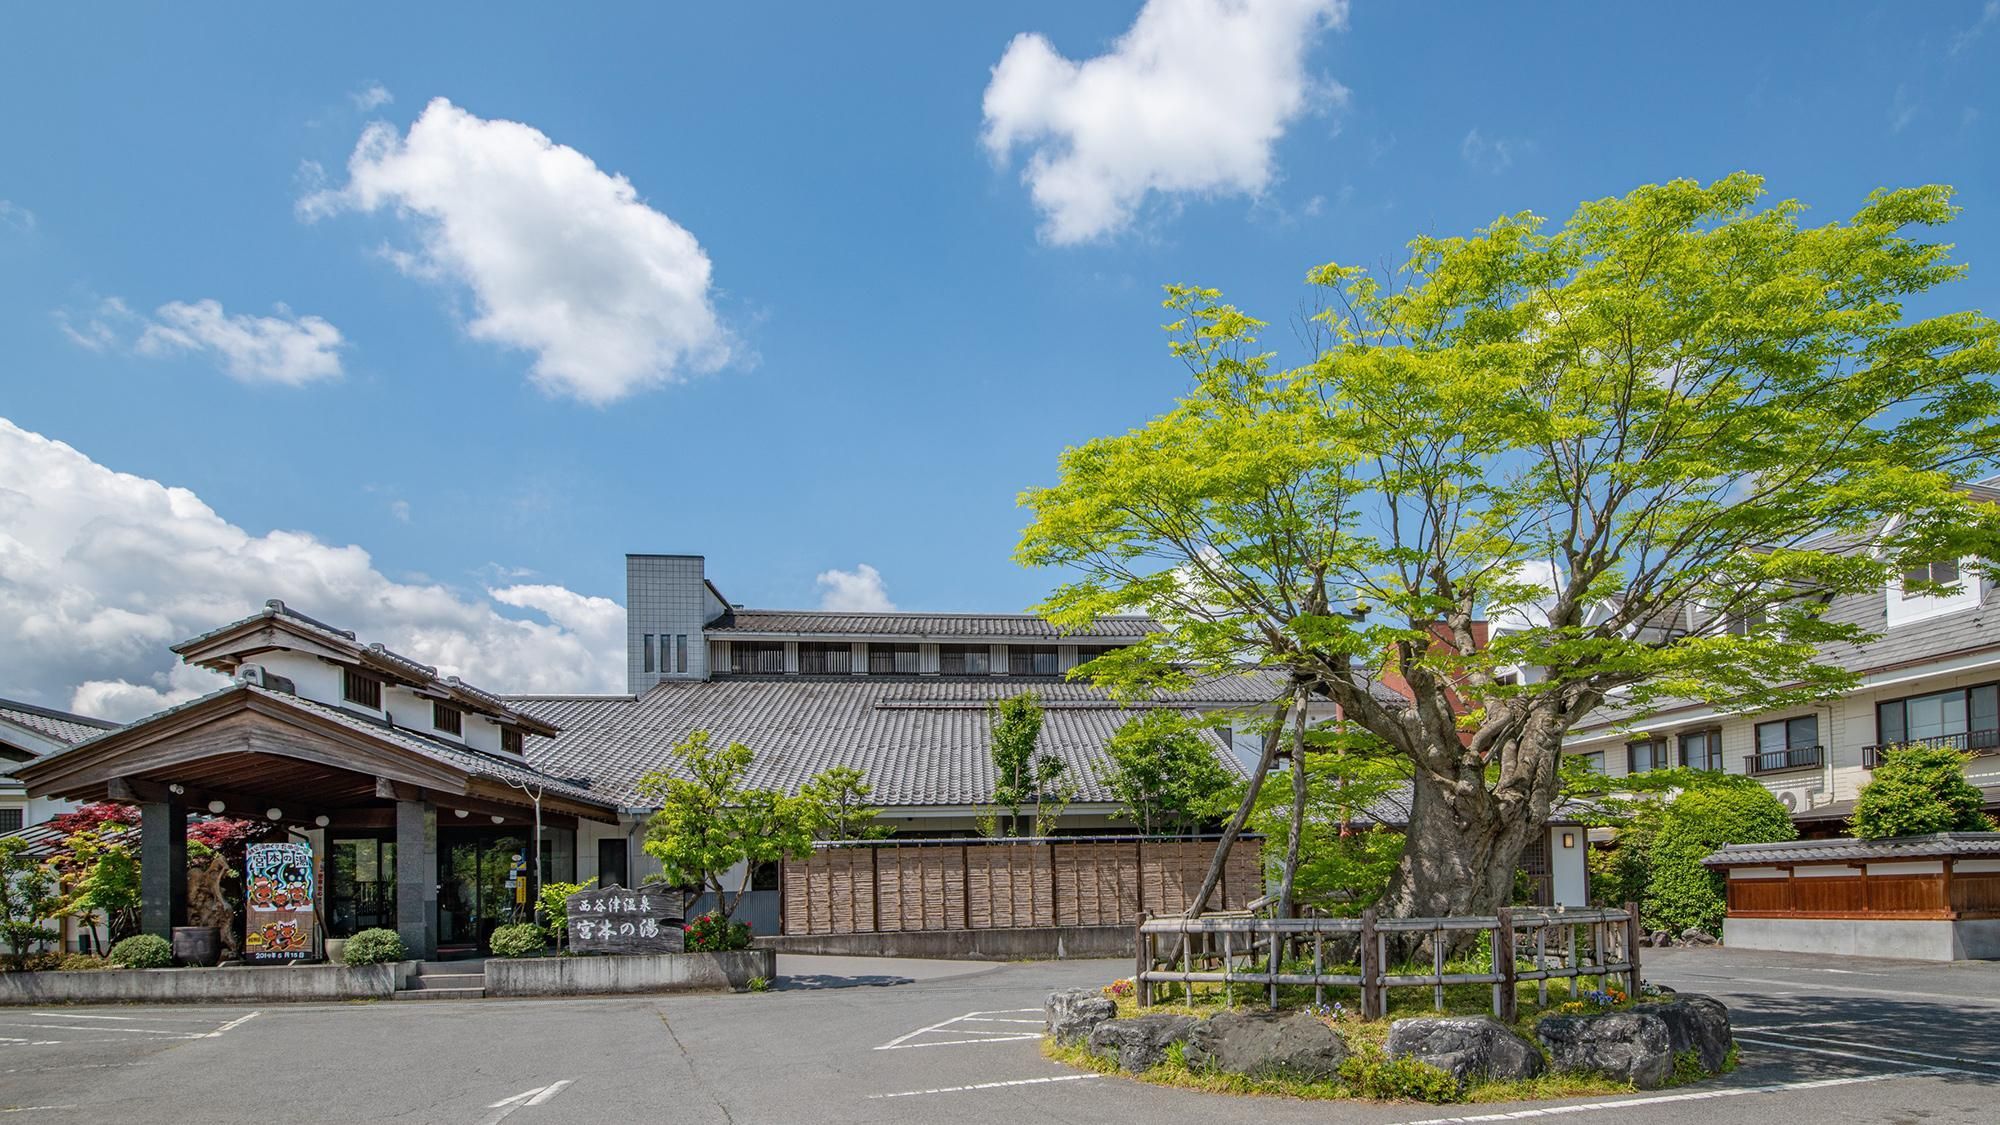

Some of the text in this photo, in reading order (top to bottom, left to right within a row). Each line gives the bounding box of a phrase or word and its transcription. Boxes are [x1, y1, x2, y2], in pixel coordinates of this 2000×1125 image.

[253, 852, 308, 867] 宮本の湯
[578, 895, 651, 913] 西谷津温泉
[576, 918, 659, 940] 宮本の湯
